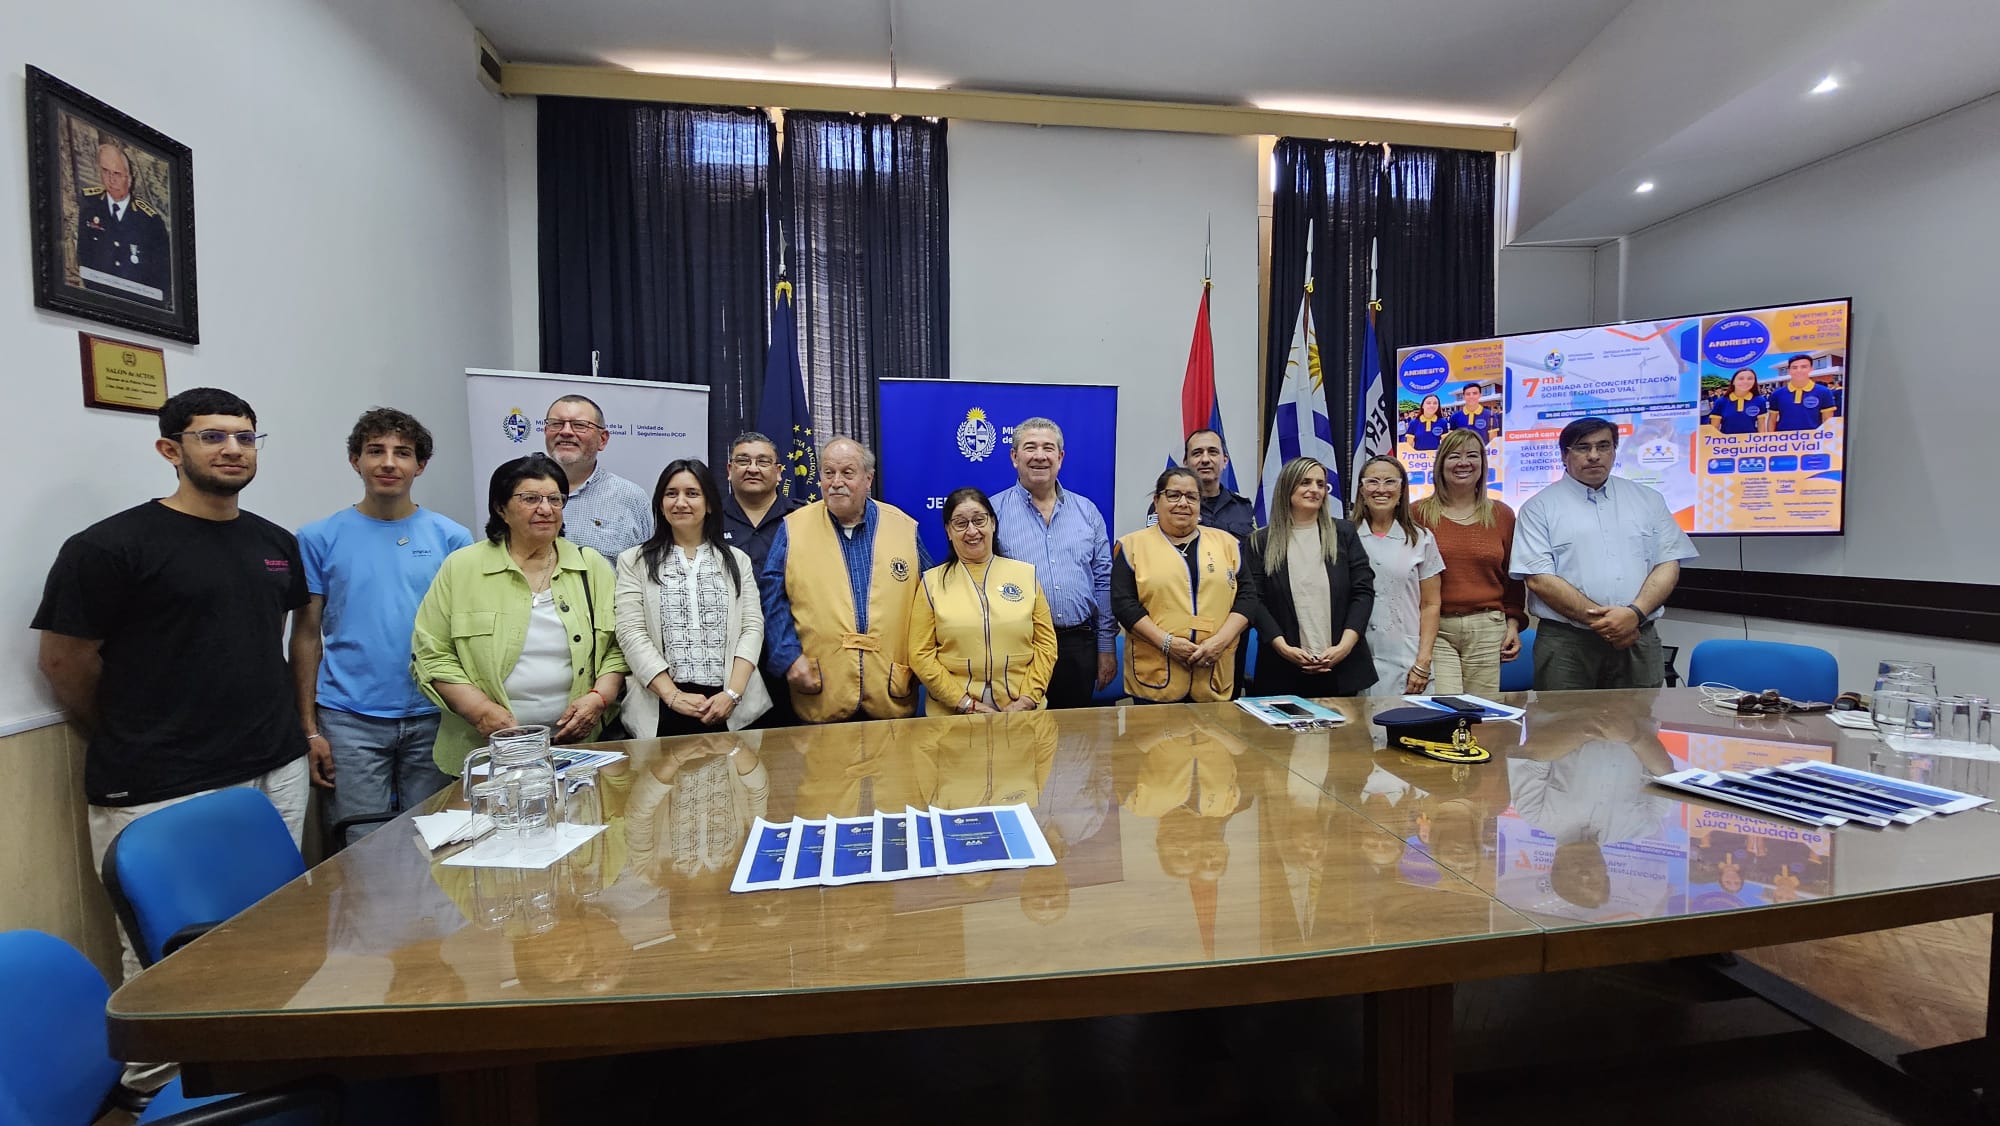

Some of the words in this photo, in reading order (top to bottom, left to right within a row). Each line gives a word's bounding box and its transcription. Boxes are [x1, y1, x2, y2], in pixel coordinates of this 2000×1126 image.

[1708, 336, 1764, 348] ANDRESITO
[1403, 367, 1446, 377] ANDRESITO
[1541, 383, 1581, 392] JORNADA
[1595, 376, 1677, 388] CONCIENTIZACIÓN
[1569, 388, 1616, 397] SEGURIDAD
[1704, 435, 1740, 445] 7ma.
[1744, 431, 1810, 443] Jornada
[1813, 430, 1834, 440] de
[1713, 443, 1788, 457] Seguridad
[1791, 441, 1820, 451] Vial
[1402, 452, 1429, 460] 7ma.
[805, 446, 817, 485] NACIONAL
